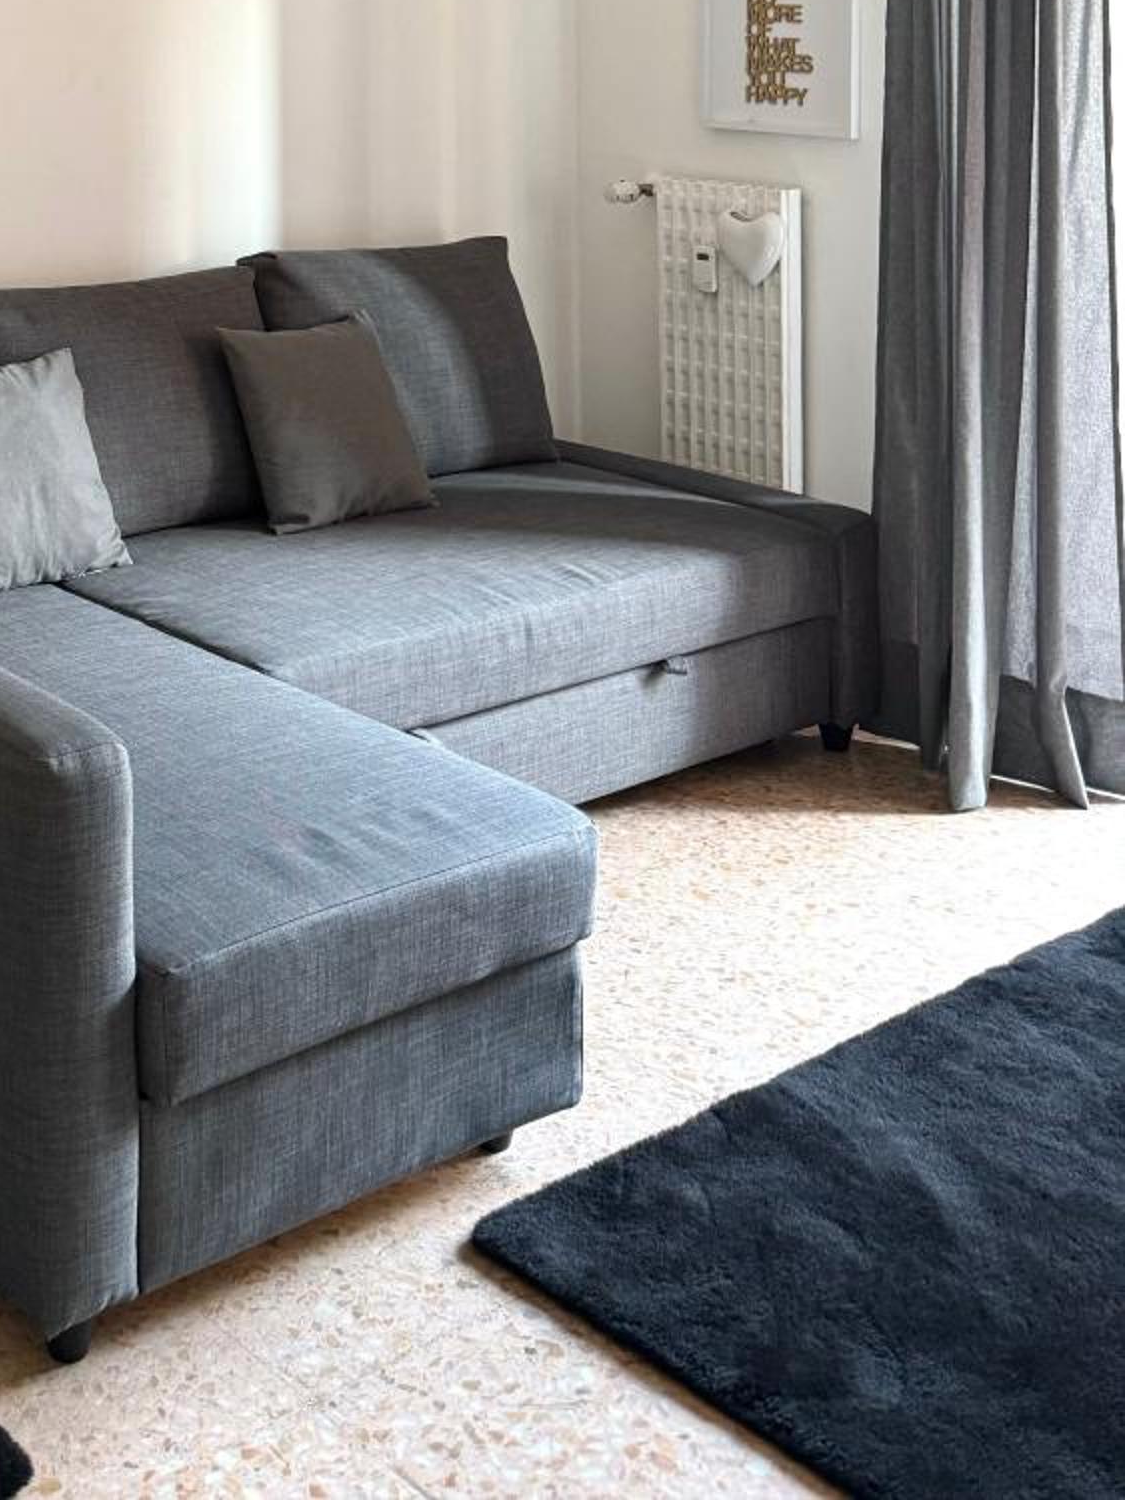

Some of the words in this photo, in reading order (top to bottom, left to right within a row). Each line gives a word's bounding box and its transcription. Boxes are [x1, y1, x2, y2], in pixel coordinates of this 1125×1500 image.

[746, 3, 803, 24] MORE
[746, 21, 773, 38] OF
[746, 71, 786, 88] YOU
[745, 85, 808, 107] HAPPY
